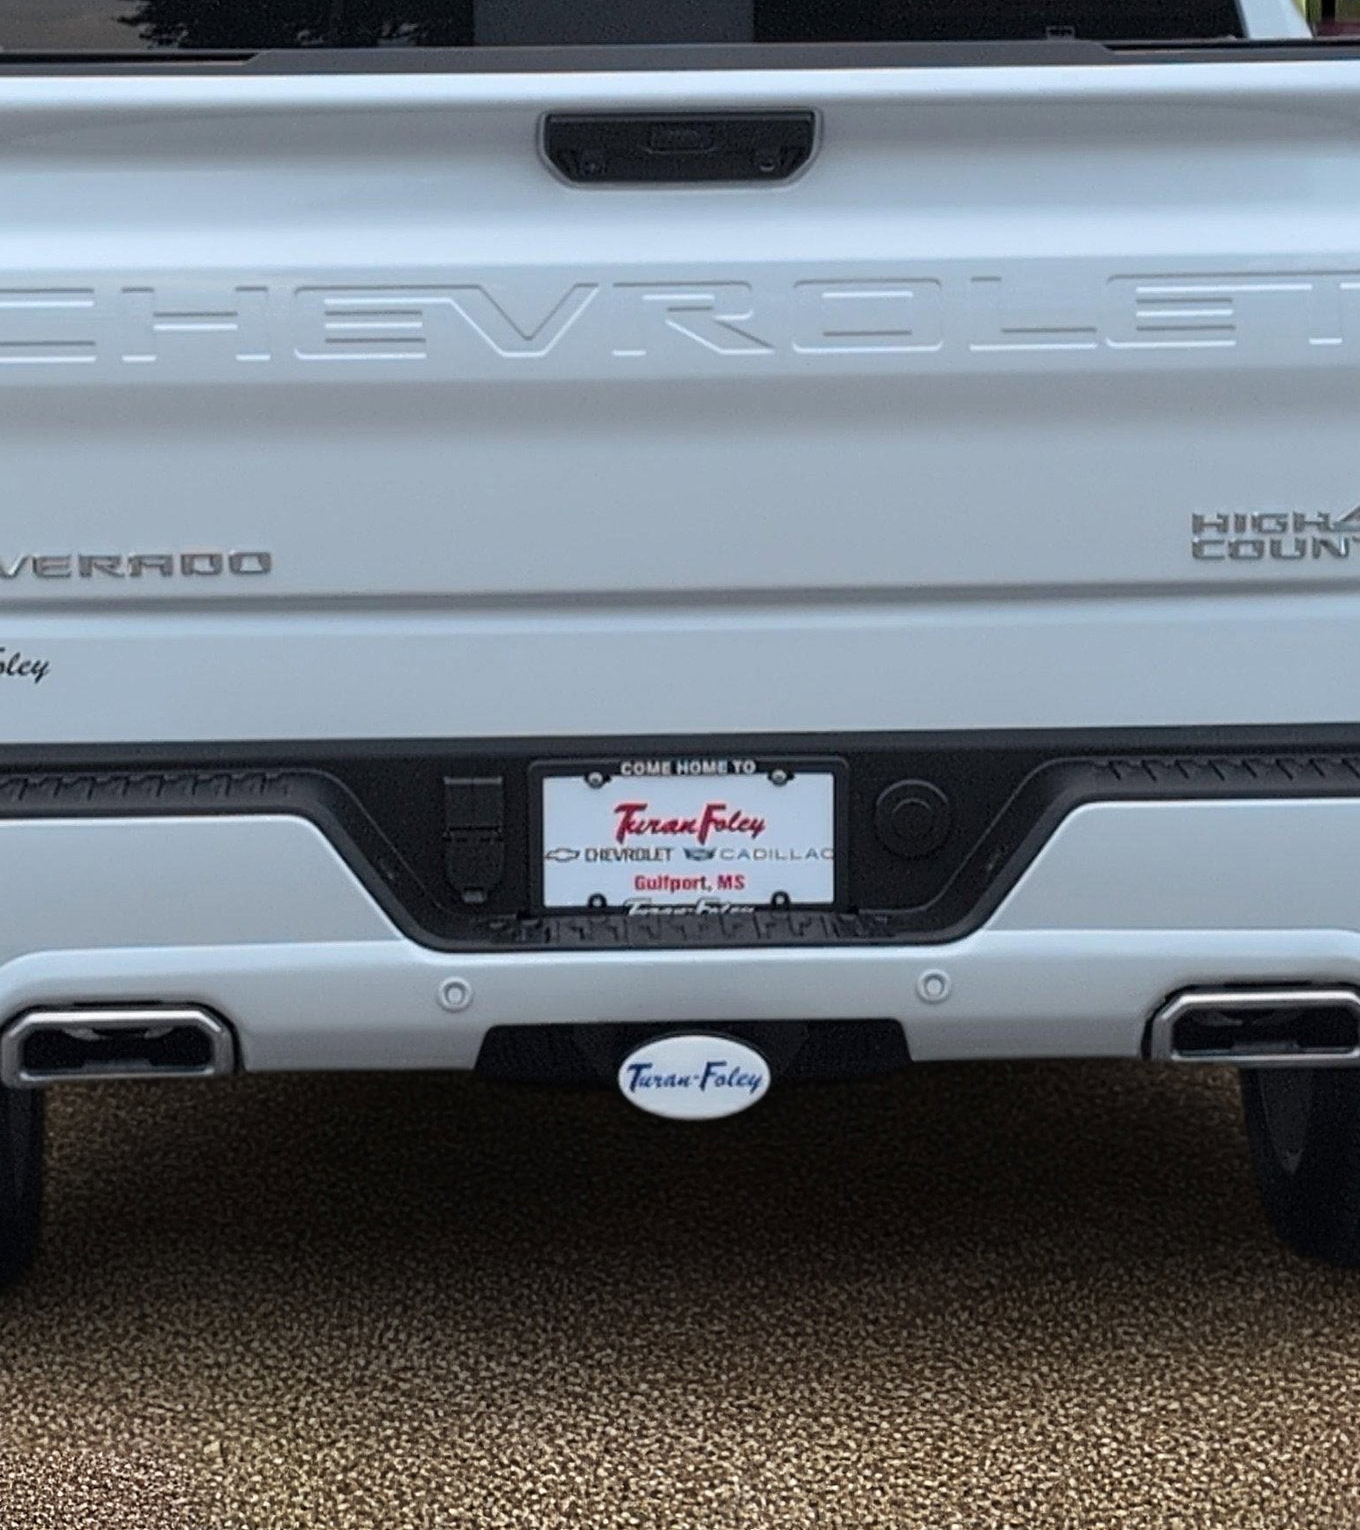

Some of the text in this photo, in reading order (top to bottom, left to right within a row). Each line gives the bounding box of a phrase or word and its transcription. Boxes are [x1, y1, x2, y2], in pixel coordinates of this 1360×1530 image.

[1191, 511, 1334, 534] HIGH
[621, 759, 757, 776] COME HOME TO
[585, 847, 835, 863] CHEVROLET CADILLAC
[634, 874, 746, 894] Gulfport, MS
